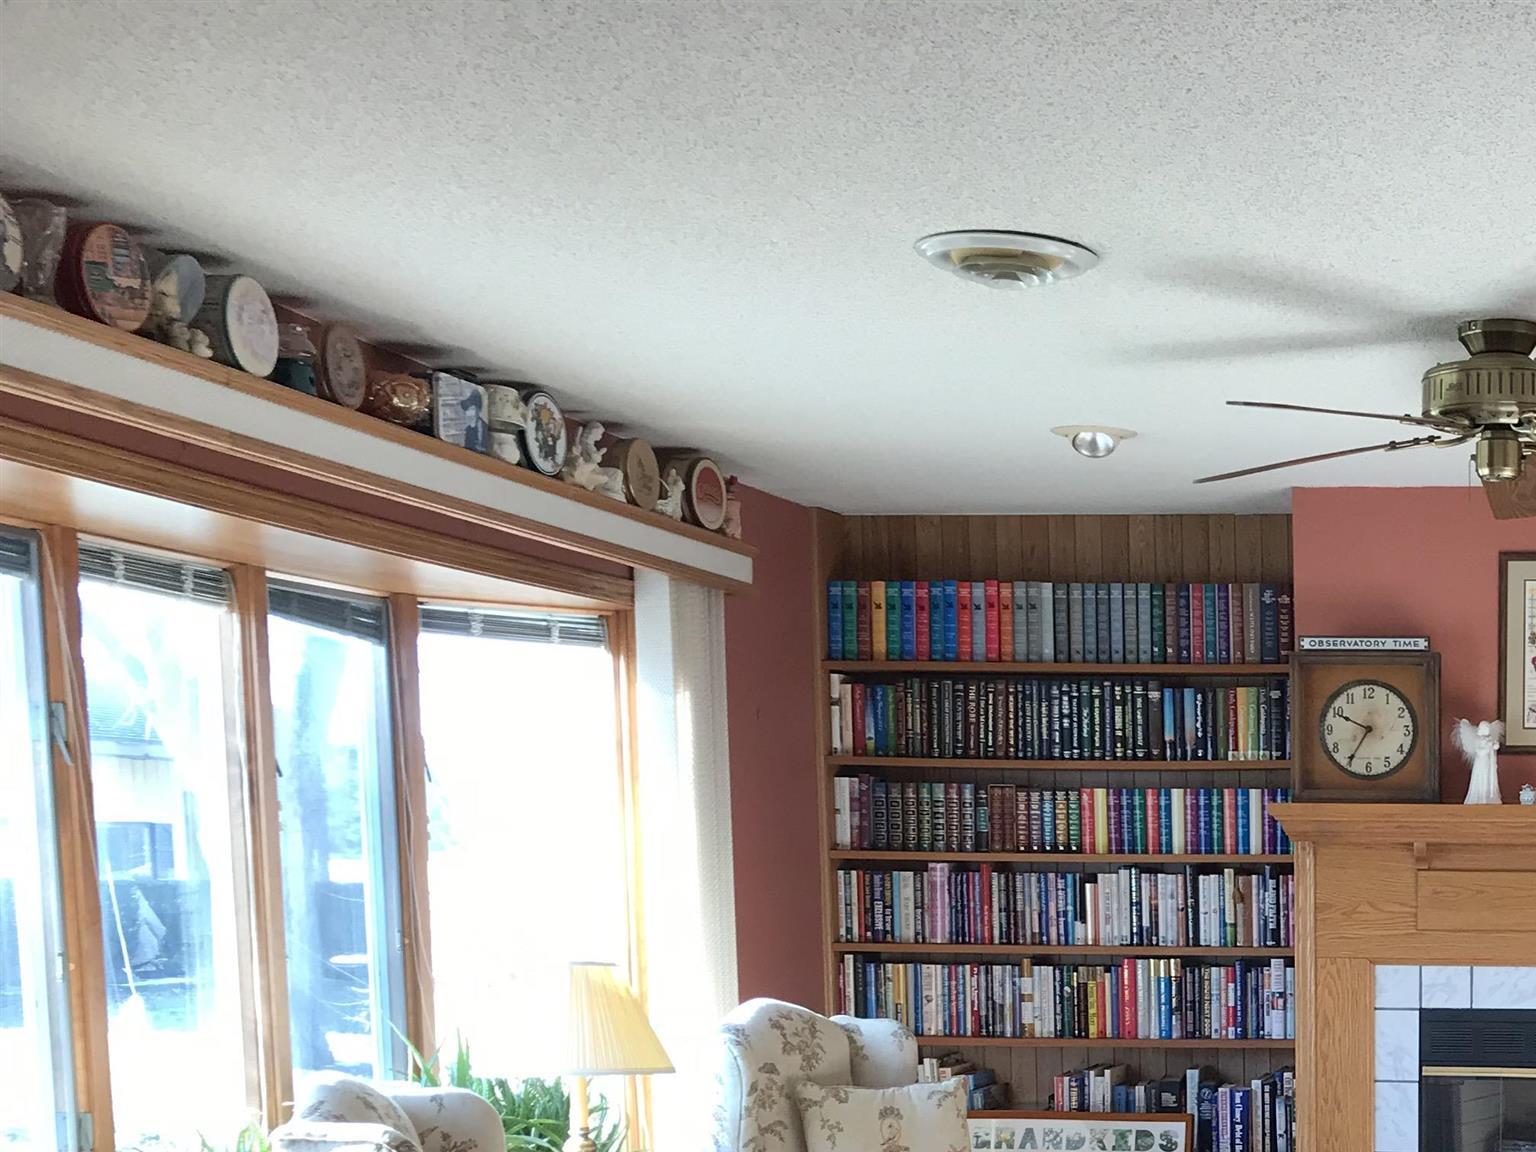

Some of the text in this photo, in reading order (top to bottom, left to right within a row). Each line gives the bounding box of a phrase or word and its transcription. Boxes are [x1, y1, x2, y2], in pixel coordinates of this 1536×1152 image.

[1308, 639, 1420, 648] OBSERVATORY TIME
[1346, 692, 1355, 704] 11
[1362, 687, 1375, 699] 12
[1385, 693, 1390, 705] 1
[1398, 707, 1406, 719] 2
[1326, 724, 1333, 736] 9
[1403, 725, 1411, 737] 3
[1332, 743, 1339, 754] 8
[1397, 744, 1405, 755] 4
[1365, 761, 1372, 773] 6
[1384, 757, 1391, 769] 5
[972, 1127, 1179, 1152] GRANDKIDS
